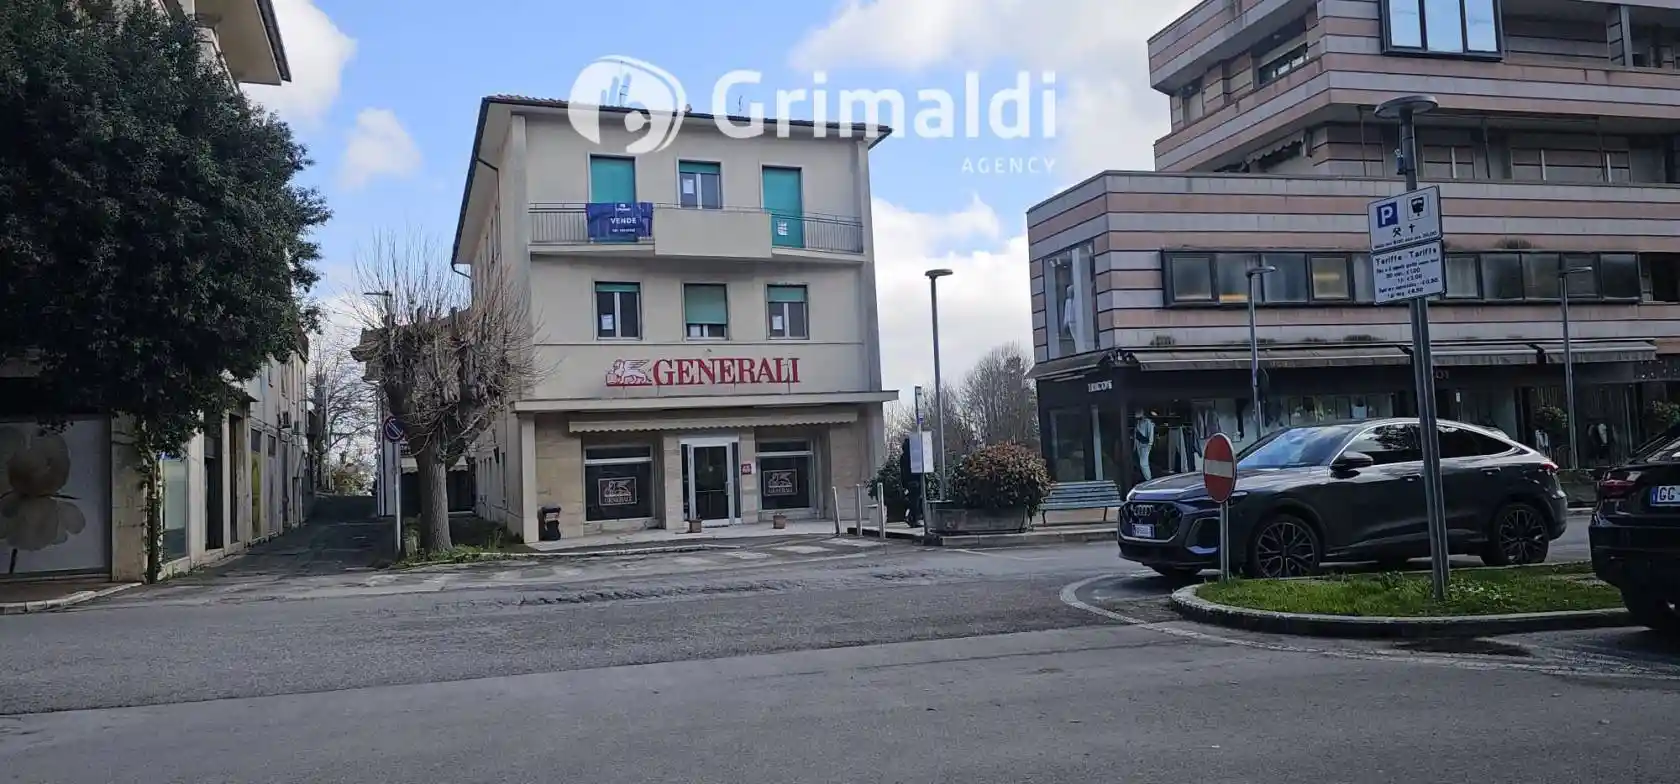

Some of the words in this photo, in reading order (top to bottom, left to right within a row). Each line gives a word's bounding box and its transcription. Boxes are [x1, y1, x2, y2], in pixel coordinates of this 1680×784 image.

[610, 217, 637, 225] VENDE
[1381, 206, 1393, 225] P
[652, 357, 801, 386] GENERALI
